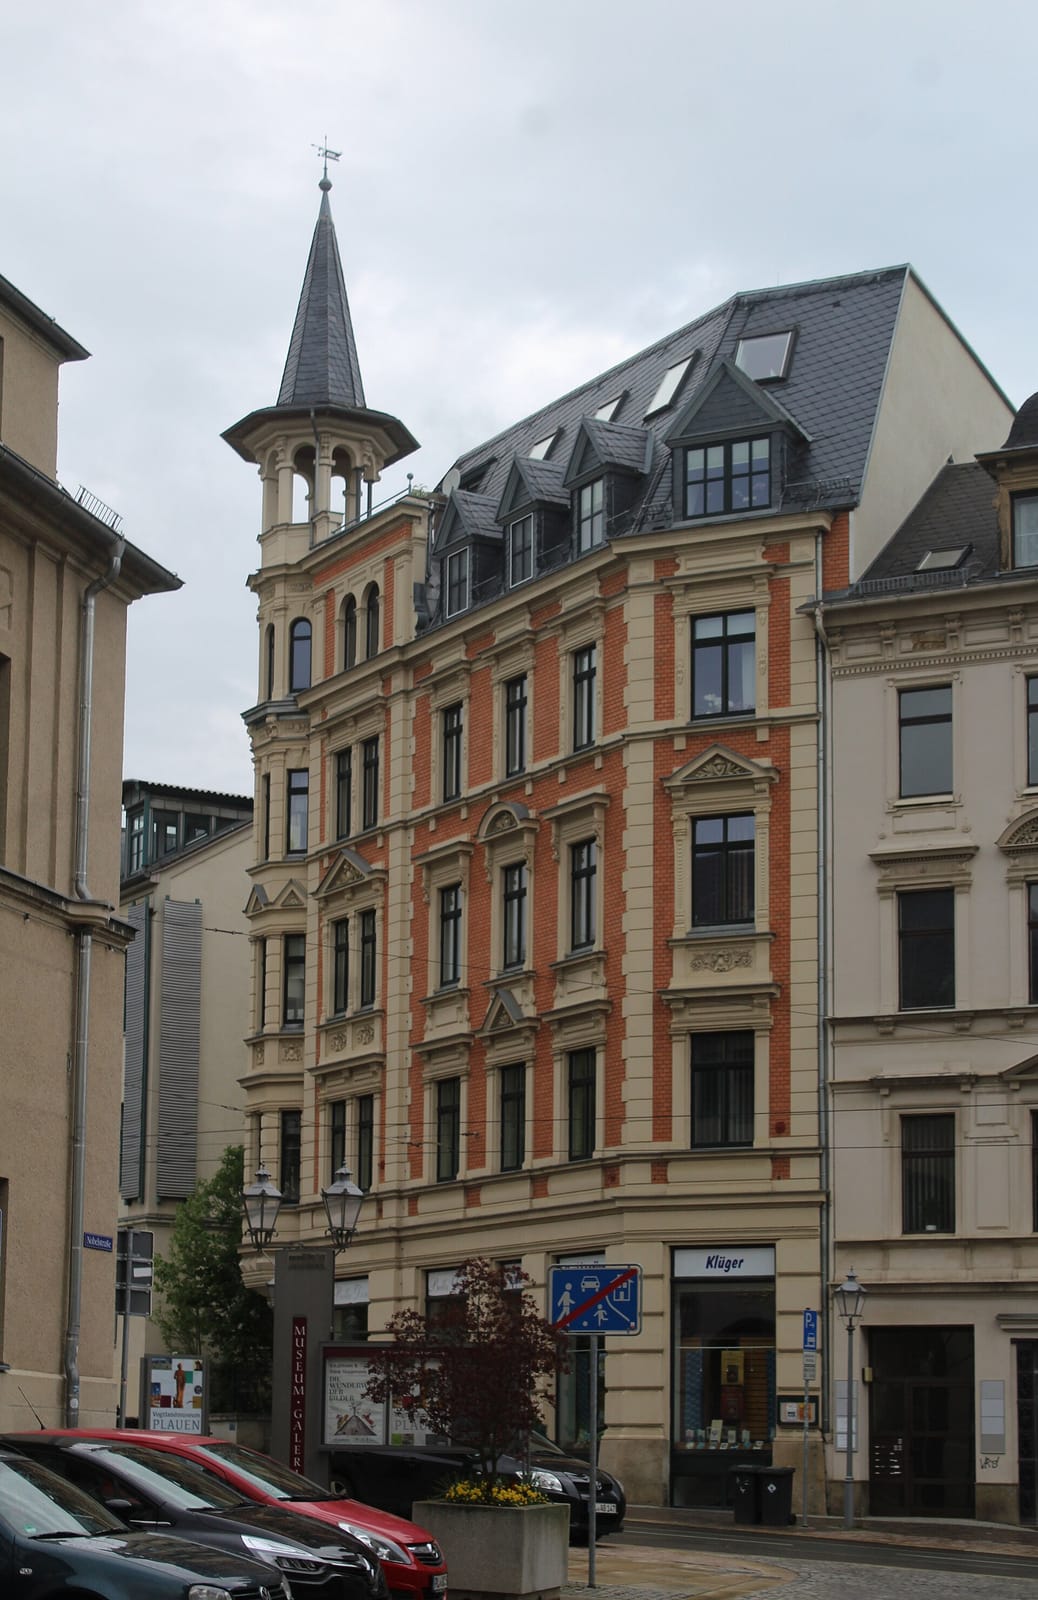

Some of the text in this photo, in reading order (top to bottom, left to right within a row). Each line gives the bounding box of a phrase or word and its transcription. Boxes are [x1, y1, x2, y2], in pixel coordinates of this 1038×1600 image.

[705, 1254, 744, 1272] Klüger
[293, 1326, 306, 1396] MUSEUM
[153, 1418, 200, 1431] PLAUEN
